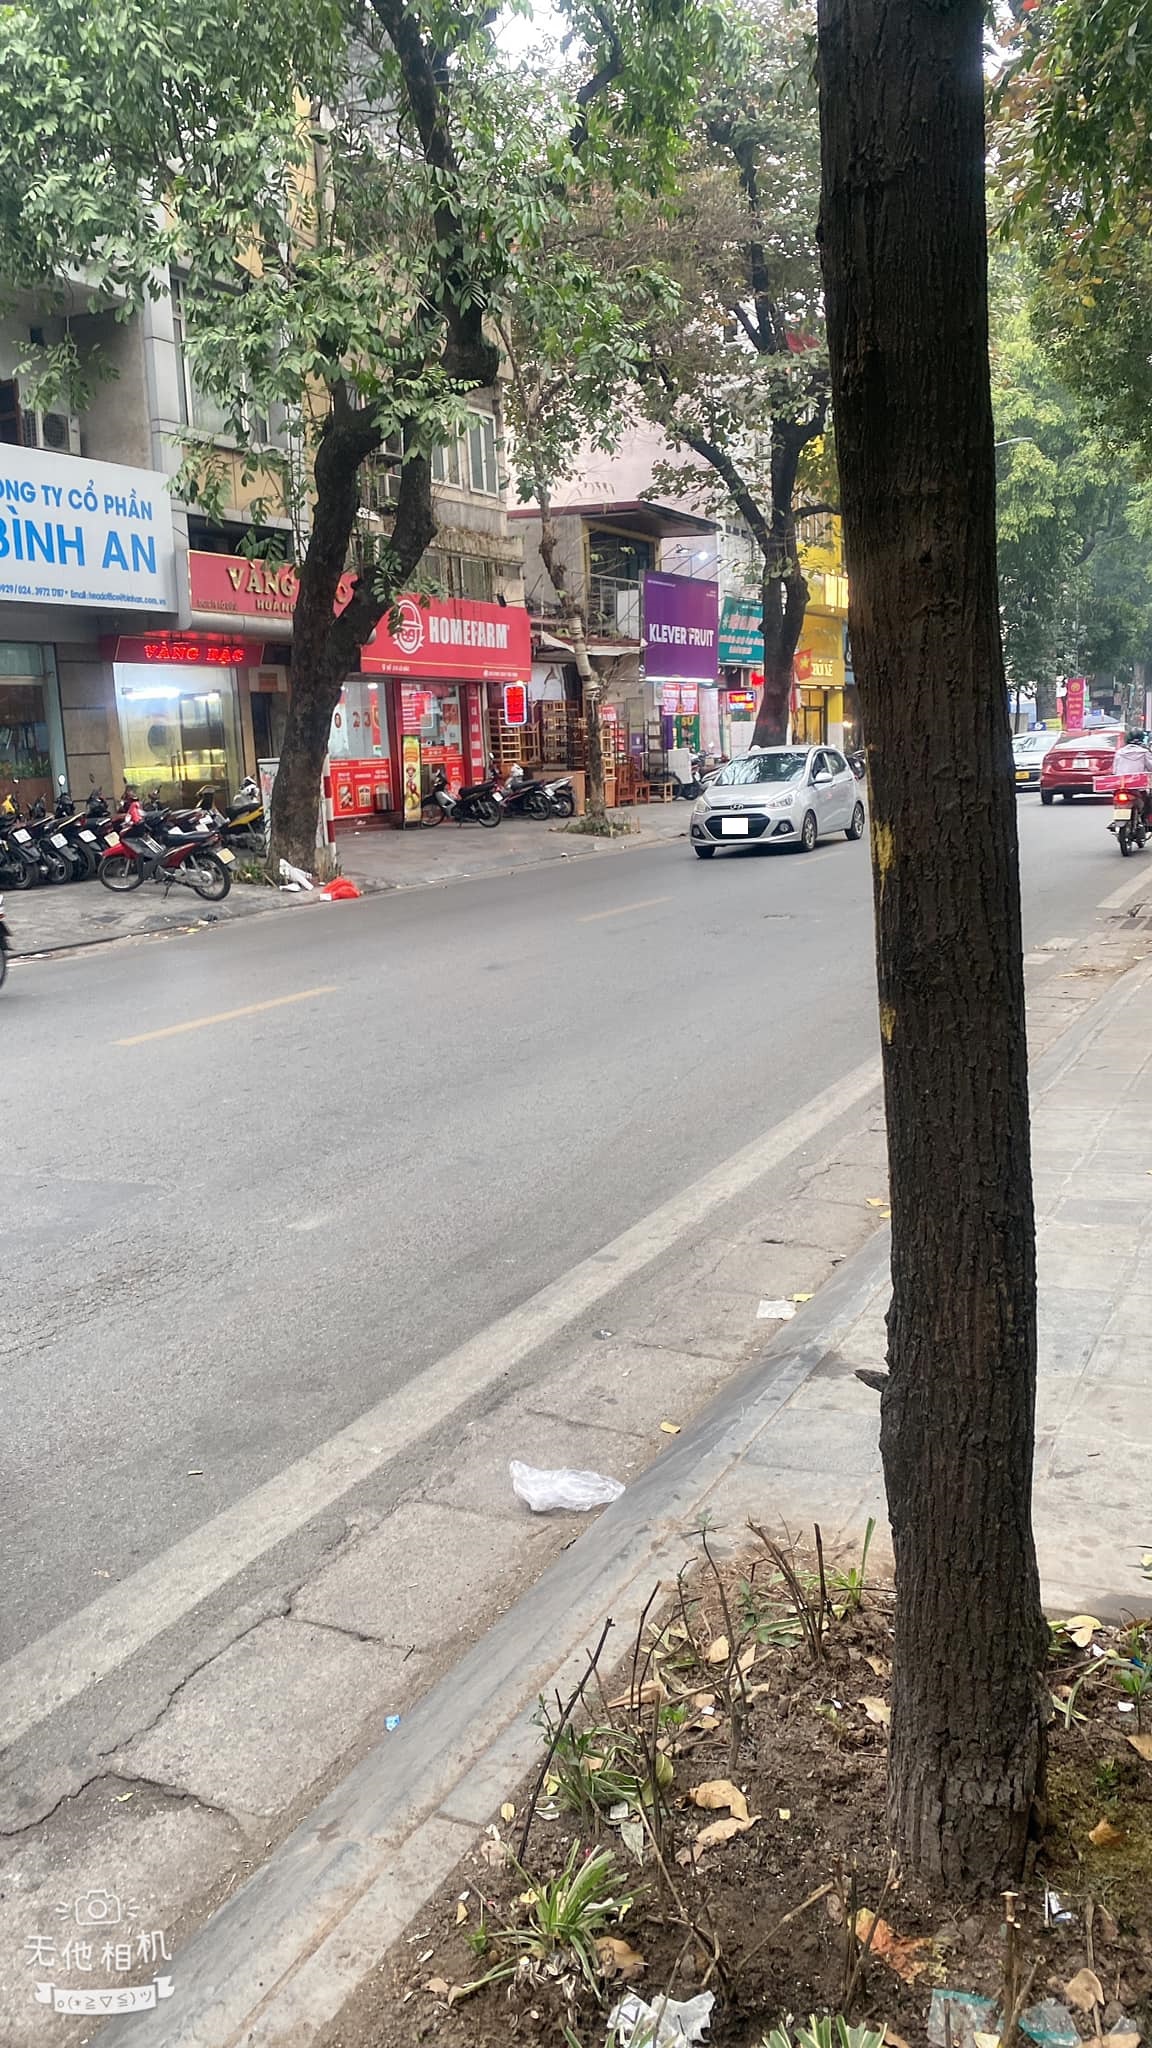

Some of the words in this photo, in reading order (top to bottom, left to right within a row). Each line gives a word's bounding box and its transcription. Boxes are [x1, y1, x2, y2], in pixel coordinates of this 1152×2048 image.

[41, 484, 63, 507] TY
[68, 479, 98, 512] CỔ
[104, 488, 153, 520] PHẦN
[102, 530, 157, 574] AN
[227, 562, 296, 597] VÀNG
[429, 616, 508, 649] HOMEFARM
[649, 623, 687, 645] KLEVER
[688, 627, 714, 647] FRUIT
[144, 641, 200, 660] VÀNG
[206, 645, 245, 664] BẠC
